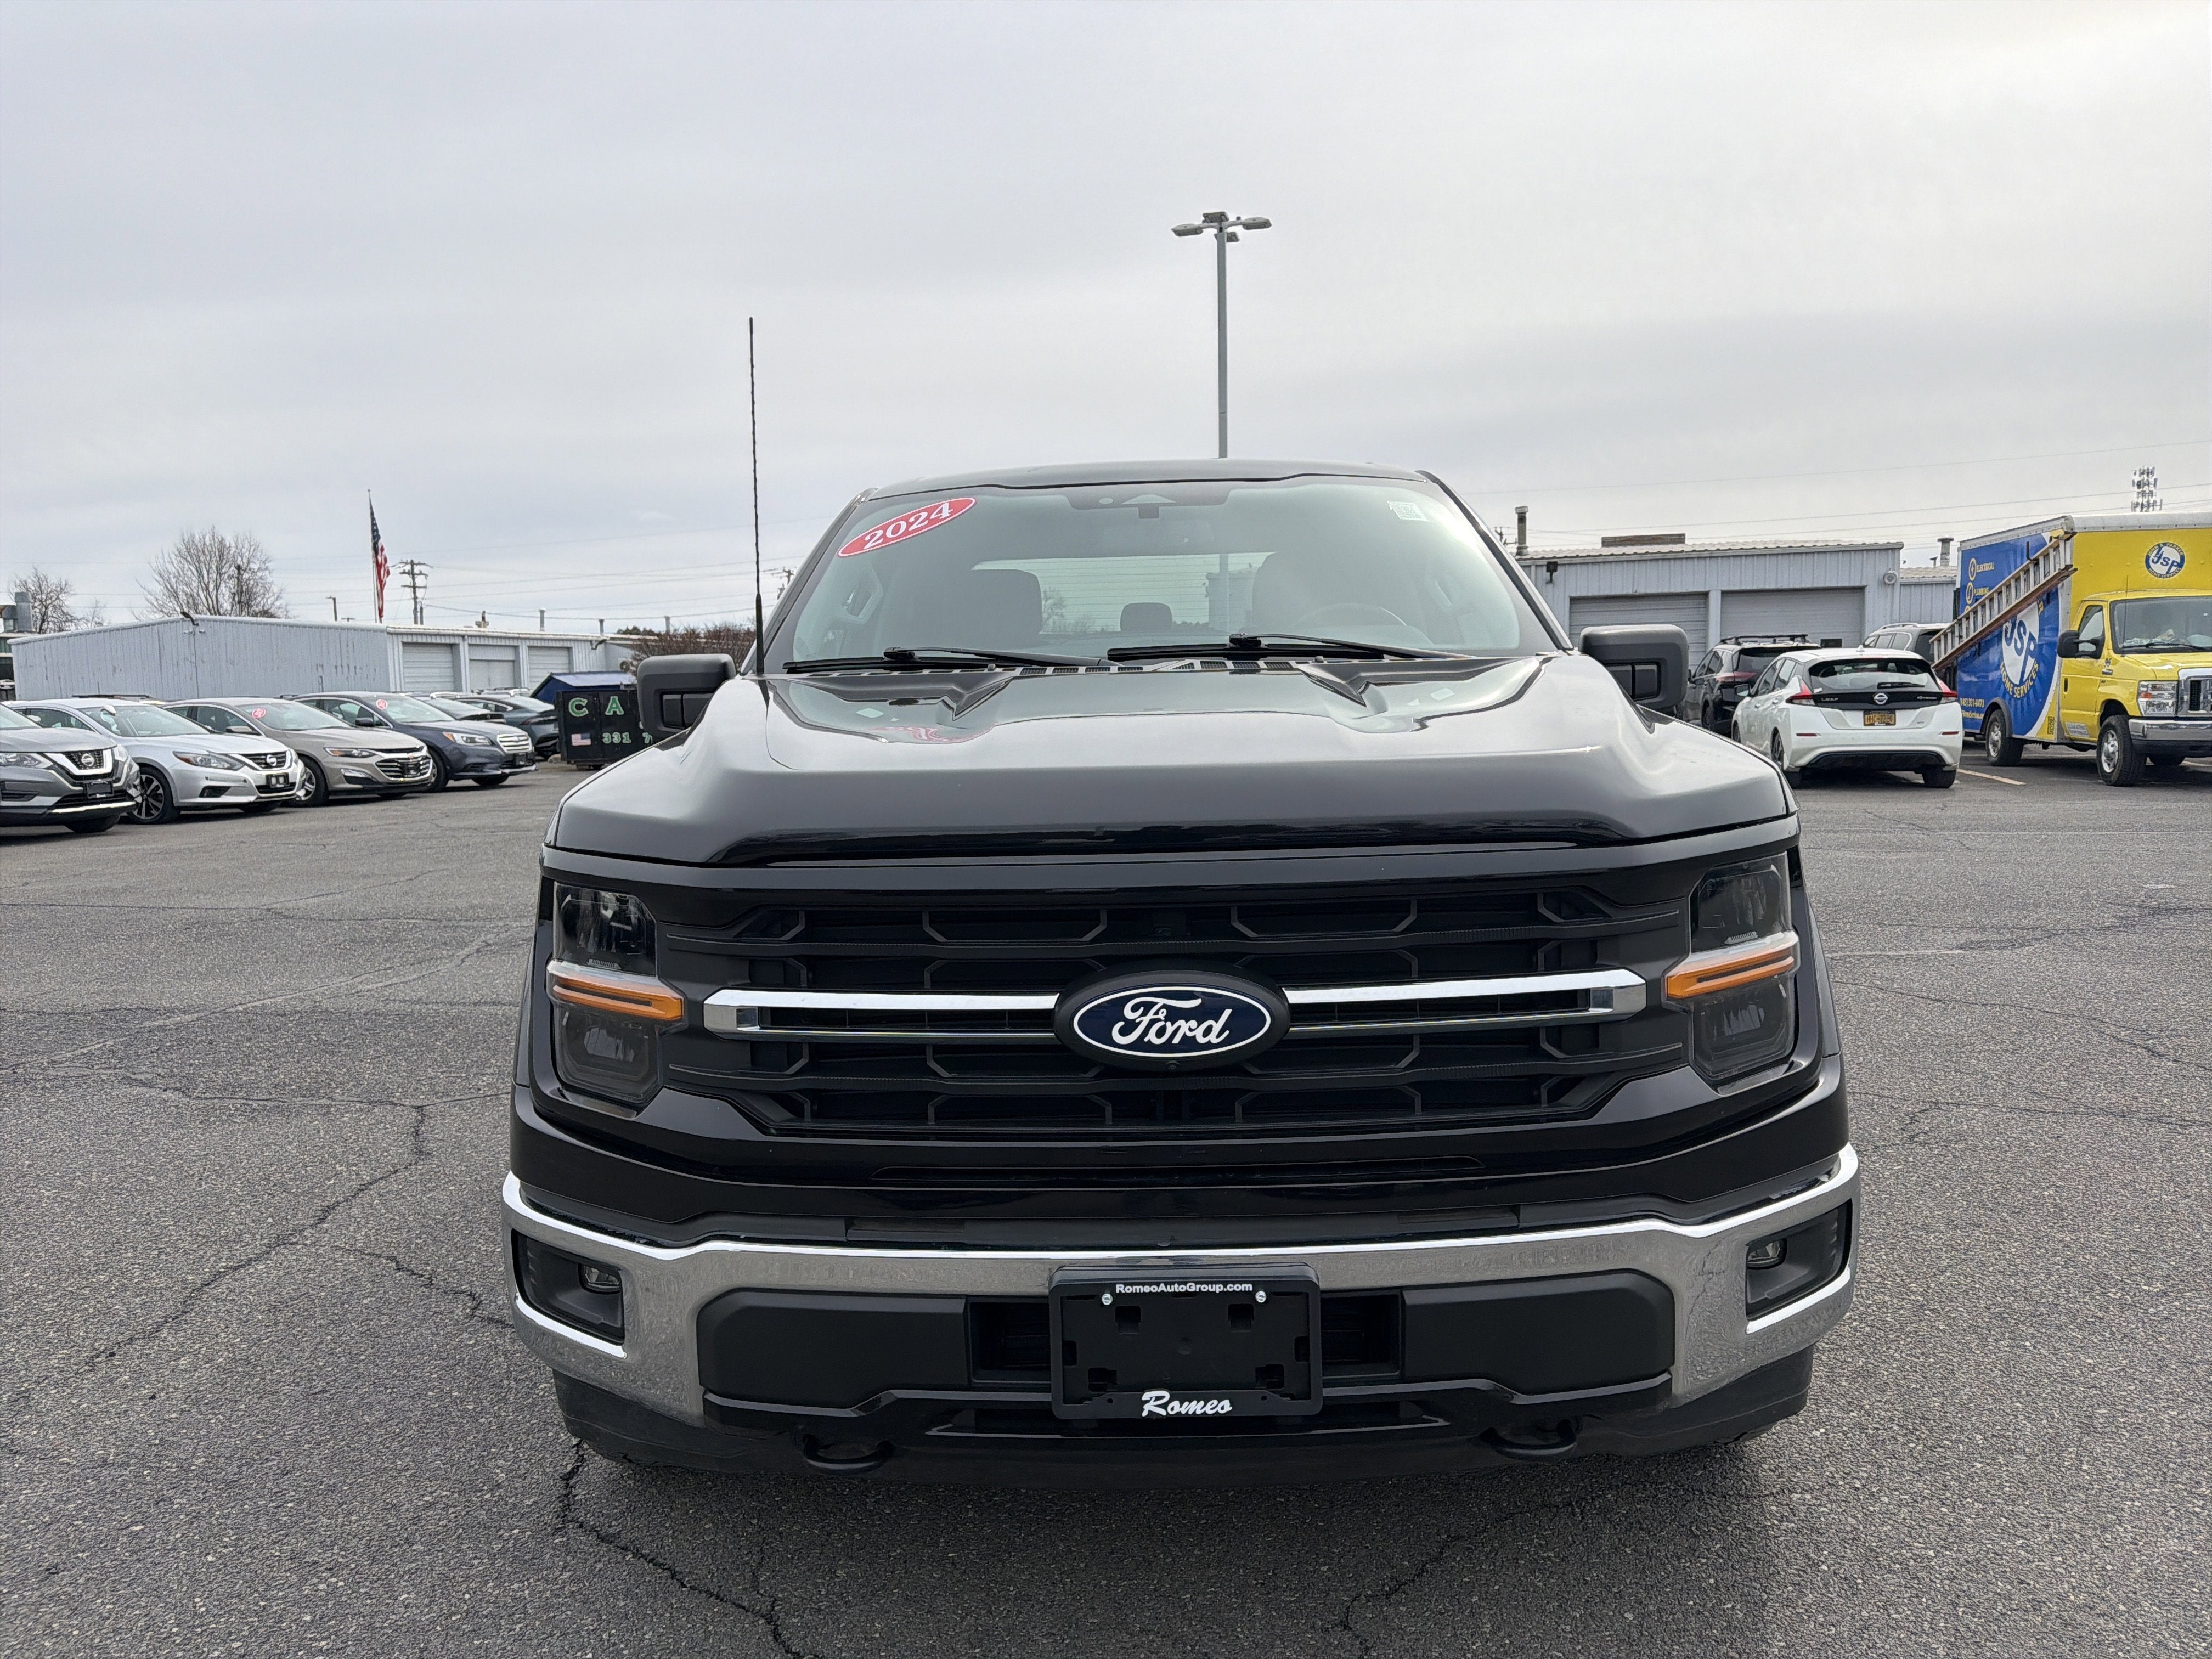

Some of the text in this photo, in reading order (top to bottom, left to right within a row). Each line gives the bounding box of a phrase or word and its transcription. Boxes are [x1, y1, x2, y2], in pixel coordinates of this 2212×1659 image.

[864, 502, 953, 550] 2024
[2166, 543, 2183, 556] PARKER
[1977, 562, 1995, 573] ELECTRICAL
[2161, 567, 2181, 578] SERVICES
[2000, 661, 2039, 698] HOME SERVICES
[602, 731, 631, 744] 331
[1111, 996, 1233, 1045] Ford
[1115, 1282, 1253, 1294] RomeoAutoGroup.com
[1141, 1390, 1233, 1417] Romeo
